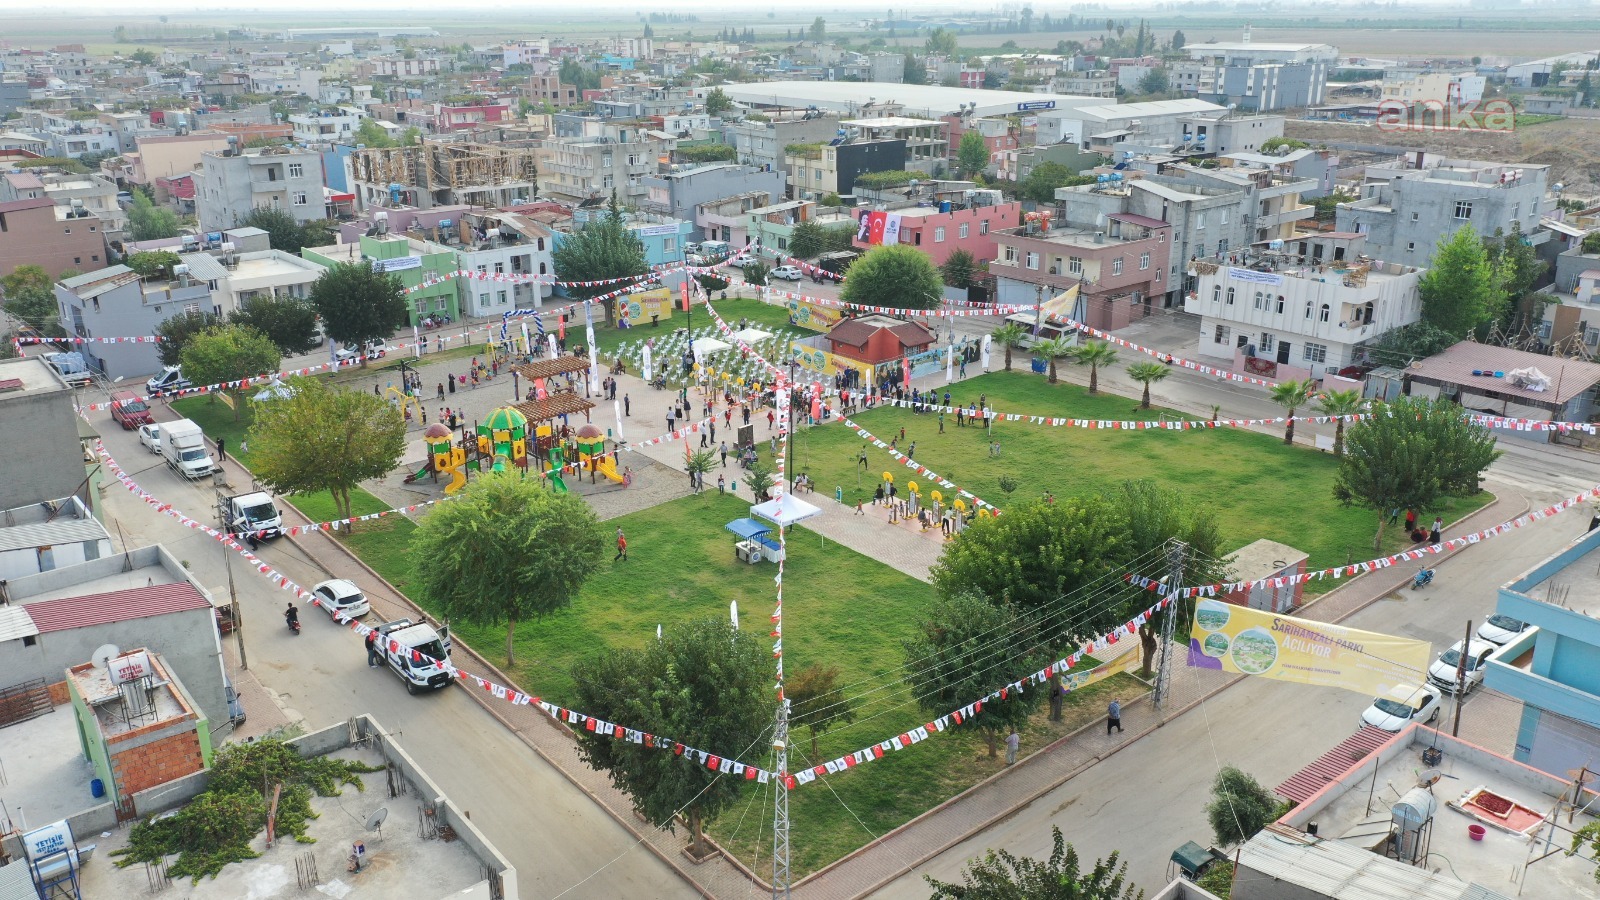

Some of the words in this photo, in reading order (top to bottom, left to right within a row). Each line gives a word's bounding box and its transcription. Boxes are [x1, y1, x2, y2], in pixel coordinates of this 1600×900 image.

[1271, 618, 1333, 644] SARIHAMZALI
[1335, 638, 1364, 653] PARKI
[1282, 635, 1332, 658] AÇILIYOR
